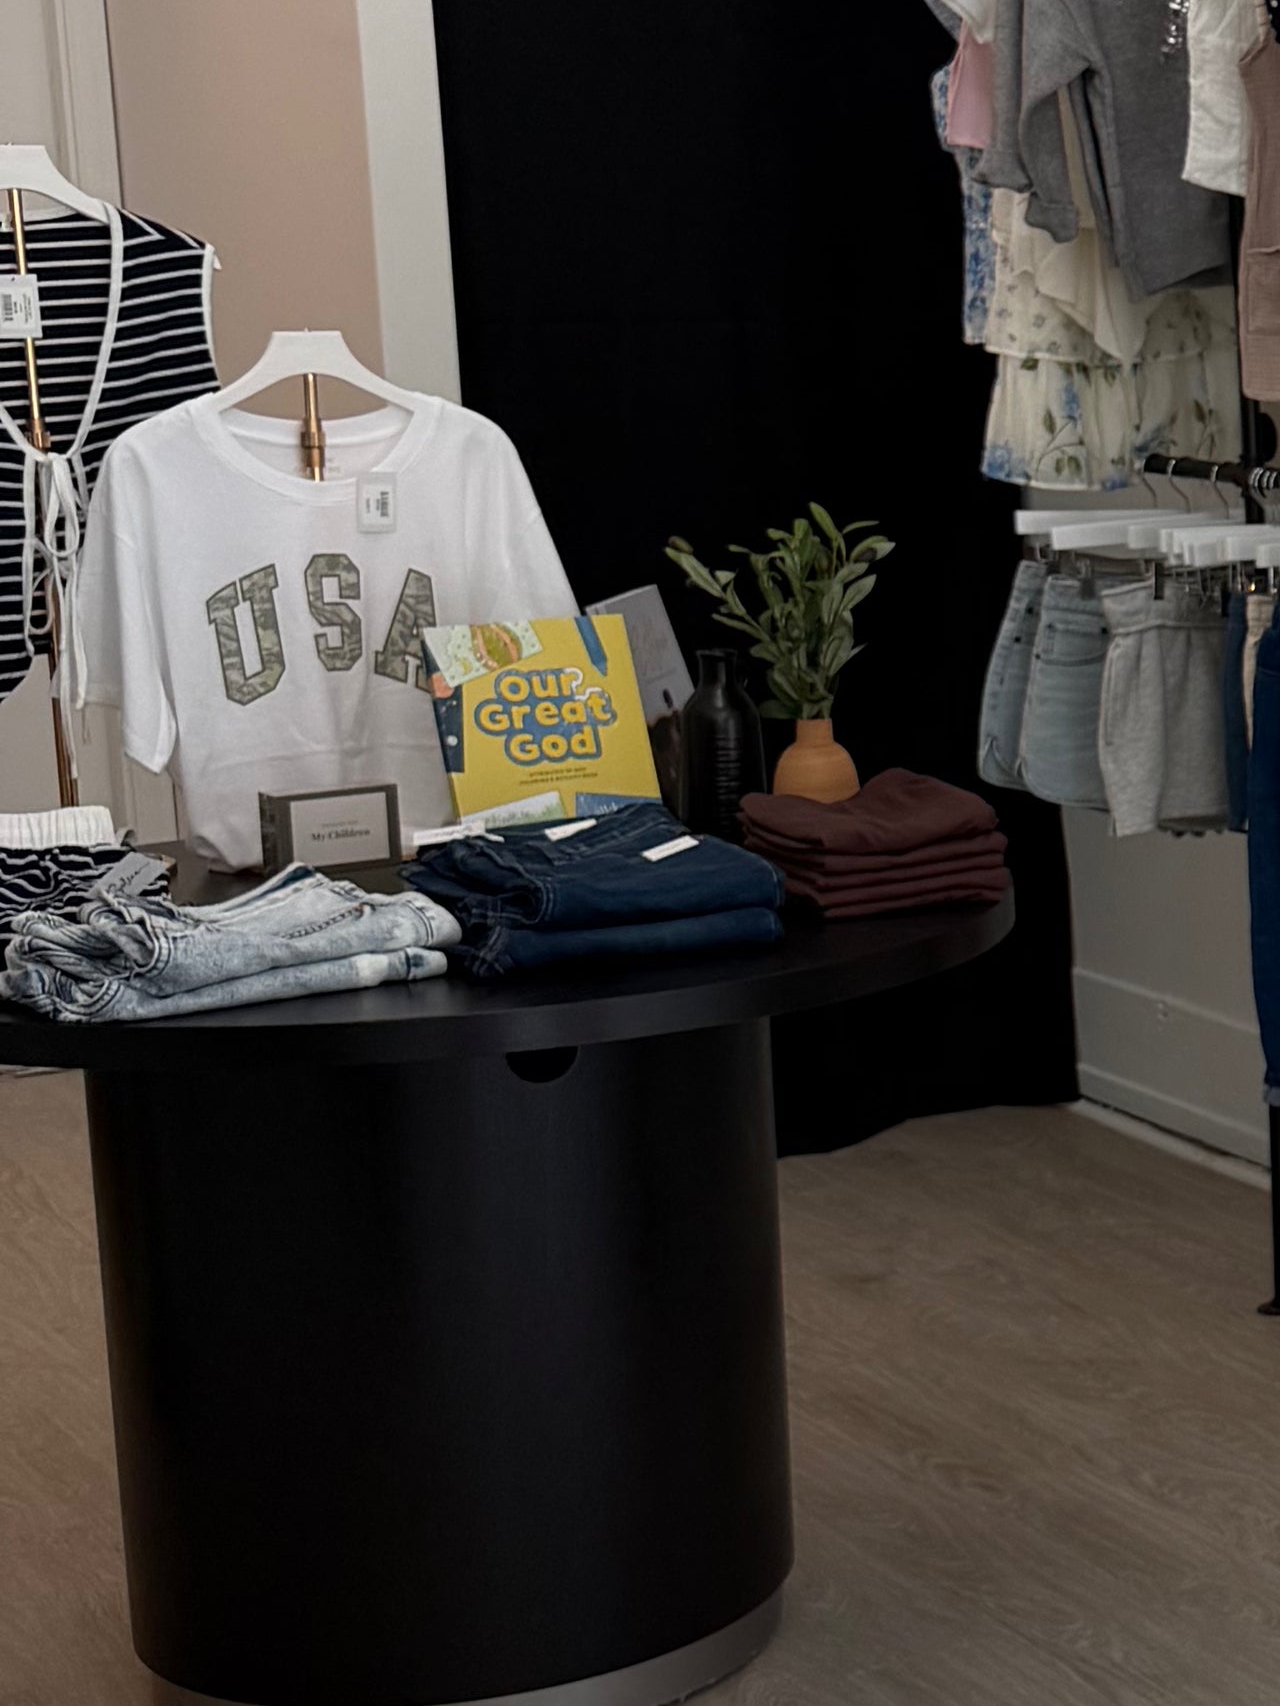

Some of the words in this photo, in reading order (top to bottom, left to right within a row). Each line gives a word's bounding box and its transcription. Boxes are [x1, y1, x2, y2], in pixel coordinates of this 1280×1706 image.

[206, 553, 437, 706] USA
[499, 672, 578, 703] Our
[478, 694, 612, 731] Great
[508, 725, 598, 762] God
